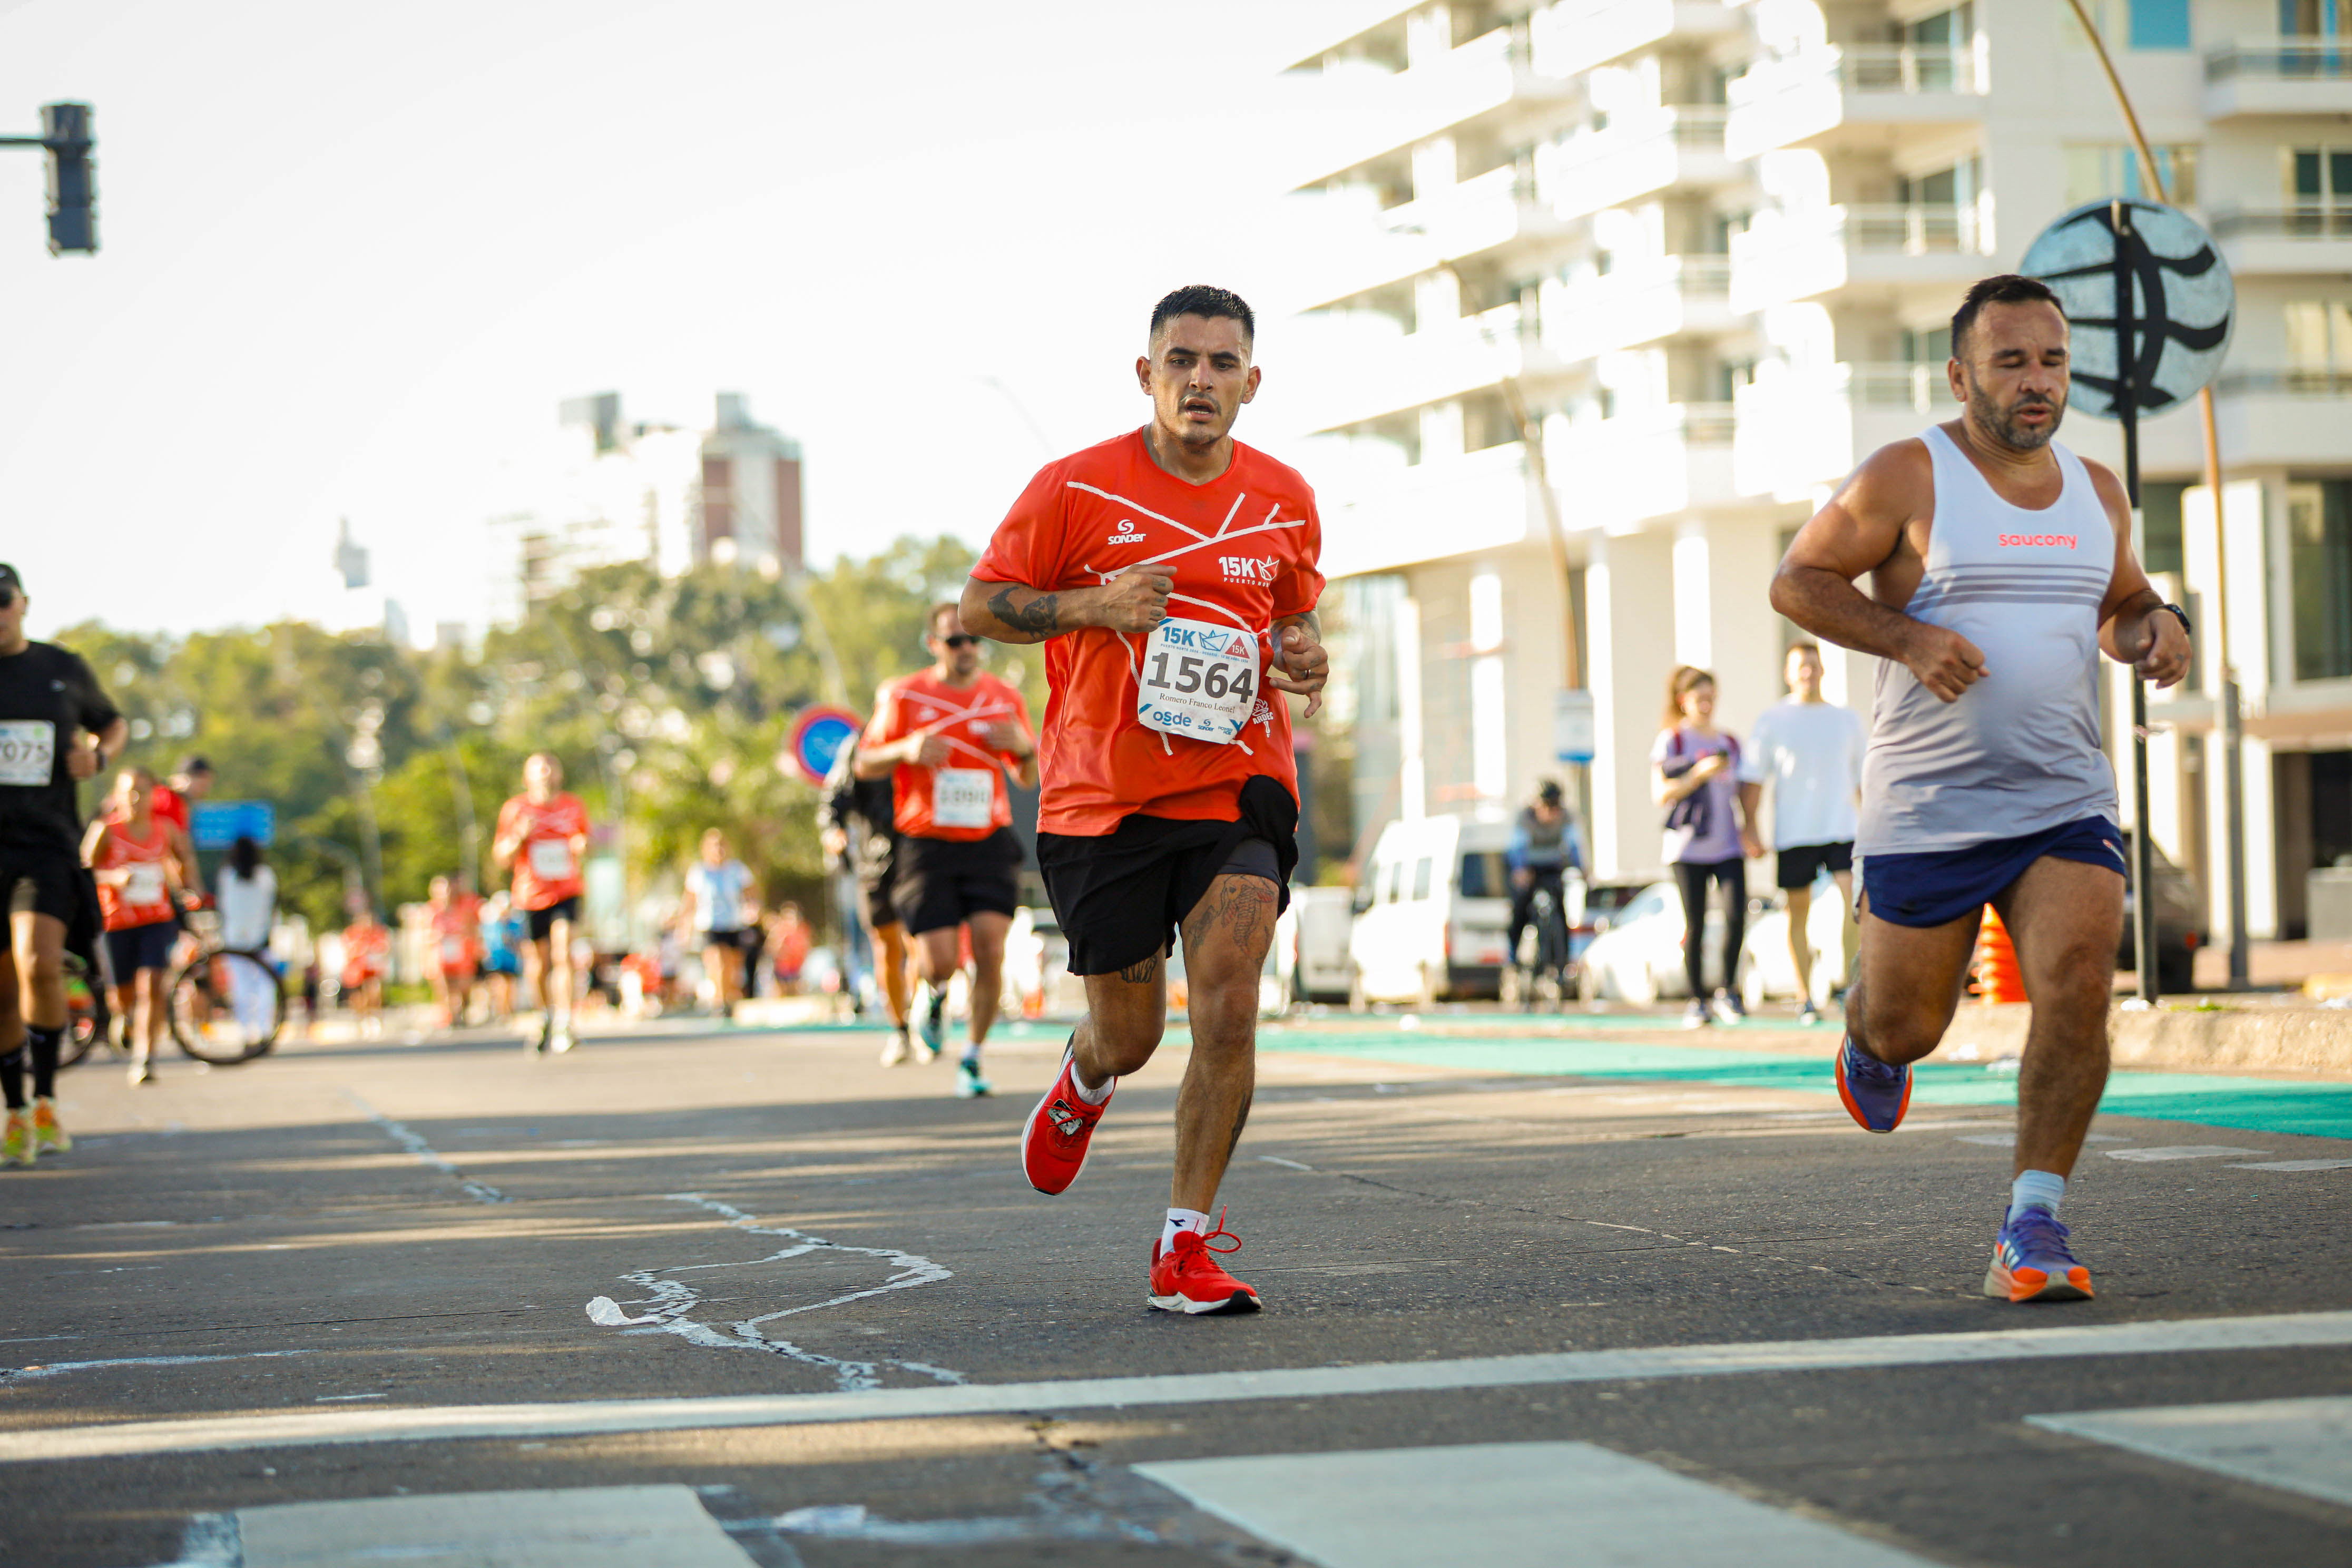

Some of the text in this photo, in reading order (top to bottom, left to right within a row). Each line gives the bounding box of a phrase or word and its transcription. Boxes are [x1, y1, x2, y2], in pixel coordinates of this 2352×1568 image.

[1998, 534, 2077, 549] saucony
[1219, 556, 1256, 577] 15K
[1163, 626, 1197, 646] 15K
[1232, 645, 1246, 655] 15K
[1148, 652, 1253, 703] 1564
[1160, 693, 1235, 713] Romero Franco Leonel
[1153, 711, 1192, 727] osde
[1252, 712, 1273, 724] ARDEC
[0, 740, 50, 762] 075
